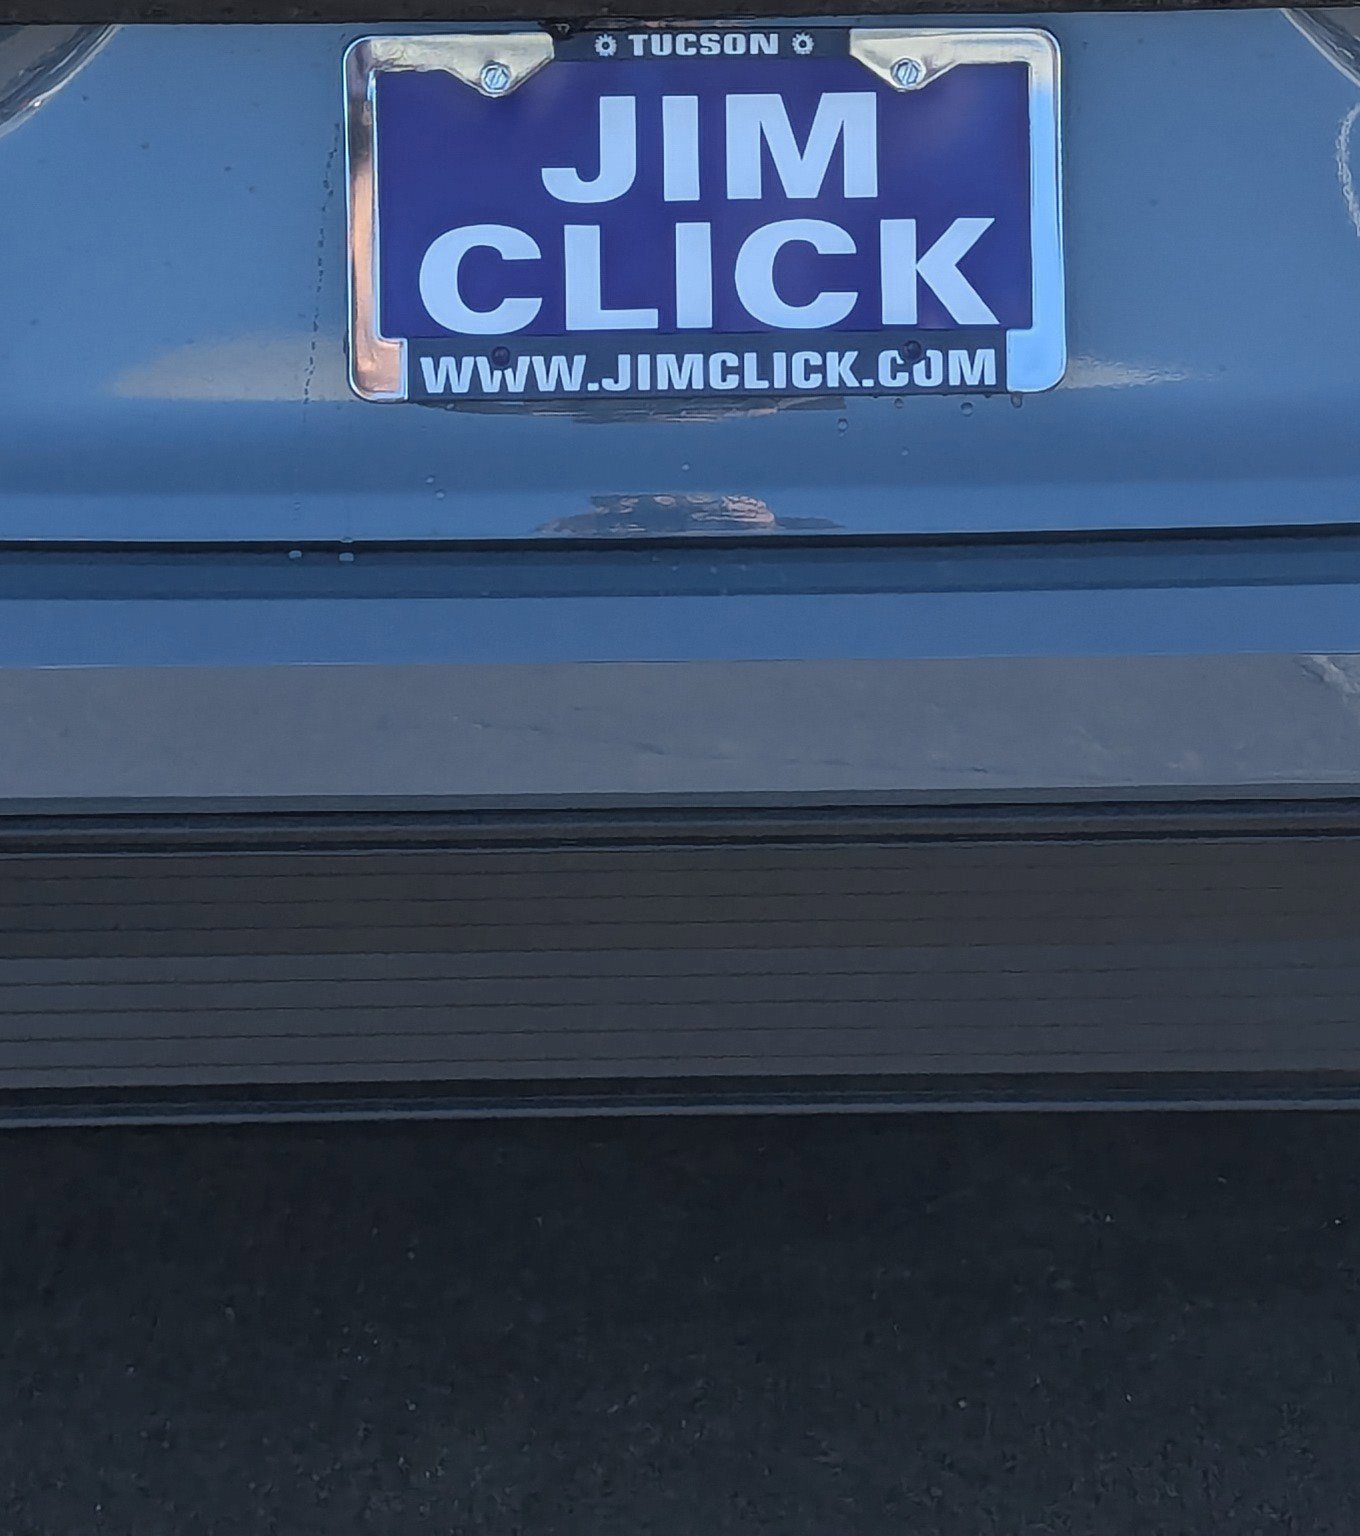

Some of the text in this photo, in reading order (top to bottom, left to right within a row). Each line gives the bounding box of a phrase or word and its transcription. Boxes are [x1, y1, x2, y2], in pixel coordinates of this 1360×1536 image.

[628, 33, 778, 56] TUCSON
[541, 92, 878, 203] JIM
[419, 217, 1000, 334] CLICK
[420, 348, 997, 393] WWW.JIMCLICK.COM
